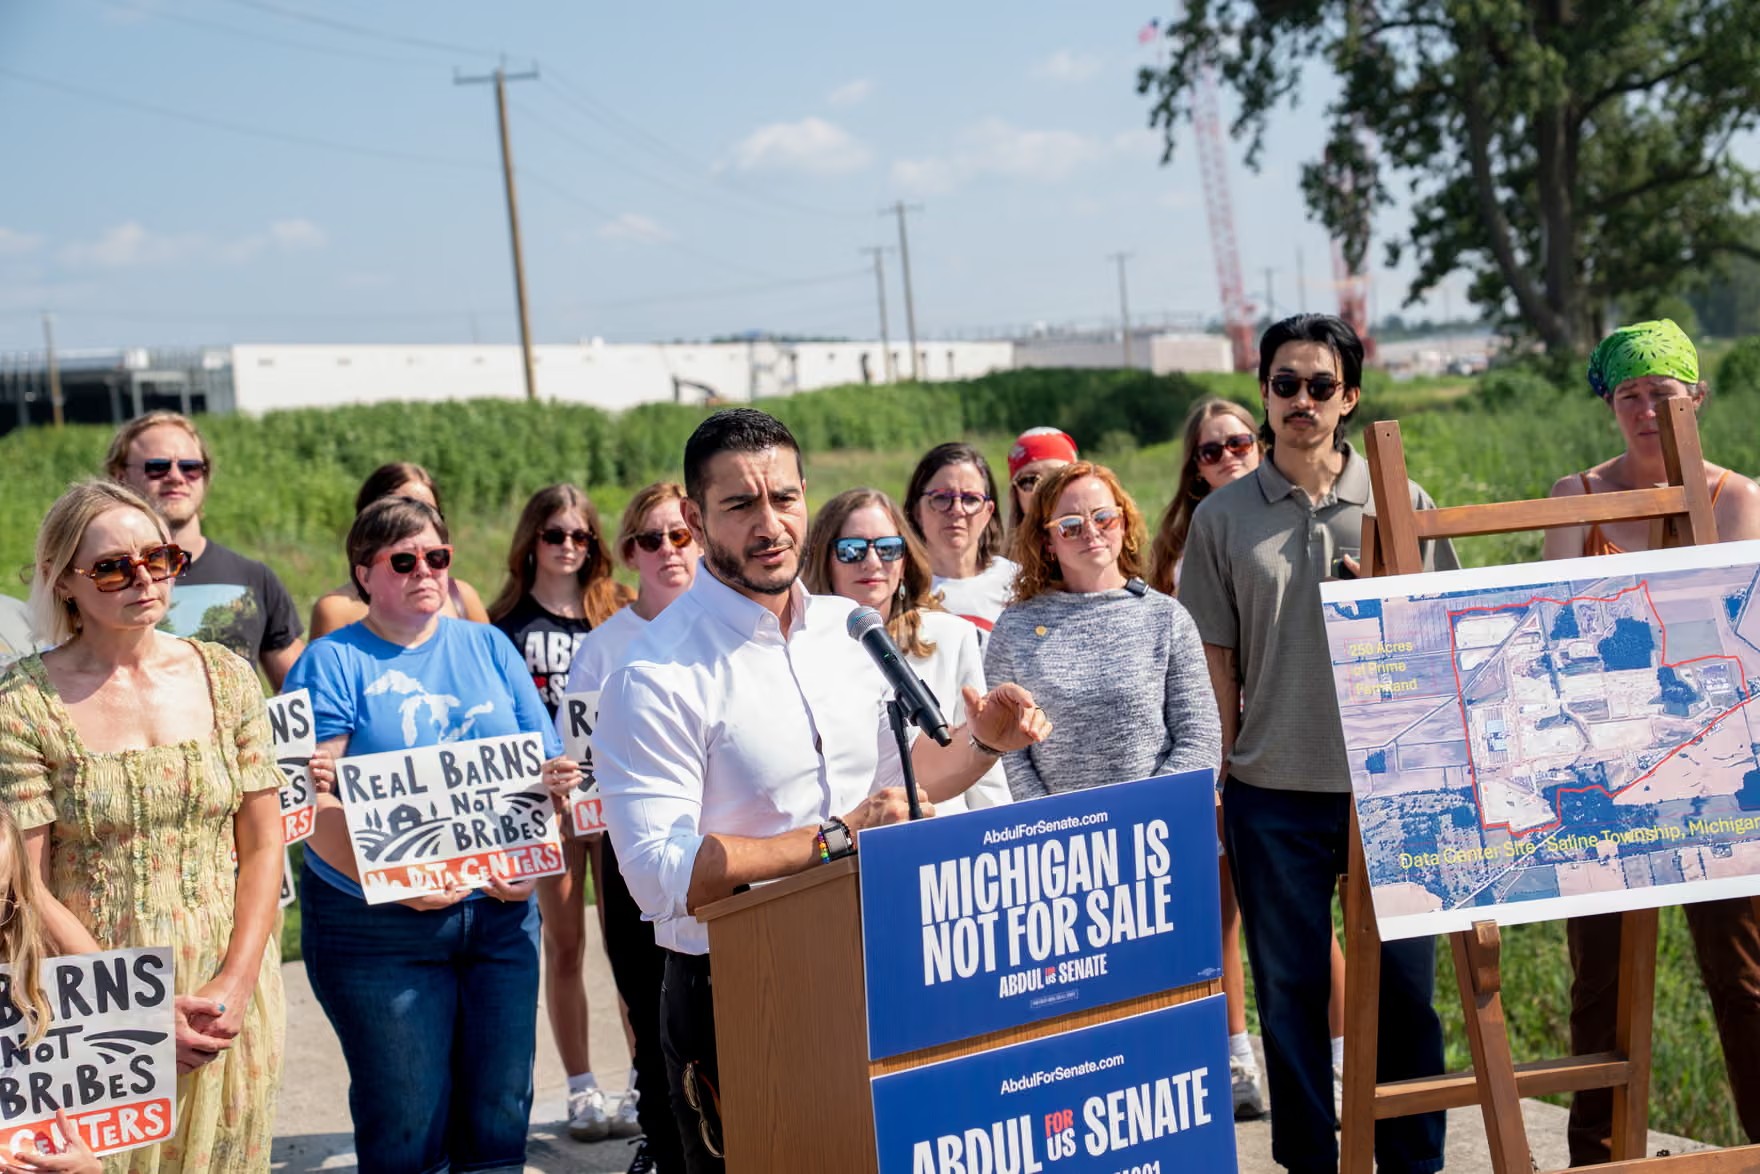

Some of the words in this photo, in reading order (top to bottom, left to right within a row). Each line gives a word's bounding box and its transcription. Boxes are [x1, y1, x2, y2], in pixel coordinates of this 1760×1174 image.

[983, 812, 1108, 845] AbdulForSenate.com
[1400, 851, 1439, 869] Data
[1443, 846, 1499, 864] Center
[1503, 841, 1535, 857] Site
[1547, 834, 1598, 852] Saline
[1601, 822, 1686, 845] Township,
[919, 828, 1119, 925] MICHIGAN
[1133, 819, 1171, 881] IS
[922, 911, 998, 986] NOT
[1007, 897, 1080, 967] FOR
[1086, 875, 1174, 948] SALE
[999, 967, 1044, 998] ABDUL
[1059, 953, 1108, 984] SENATE
[1001, 1054, 1125, 1095] AbdulForSenate.com
[1044, 1109, 1074, 1138] FOR
[1083, 1067, 1212, 1157] SENATE
[911, 1115, 1043, 1174] ABDUL
[1046, 1127, 1077, 1161] US
